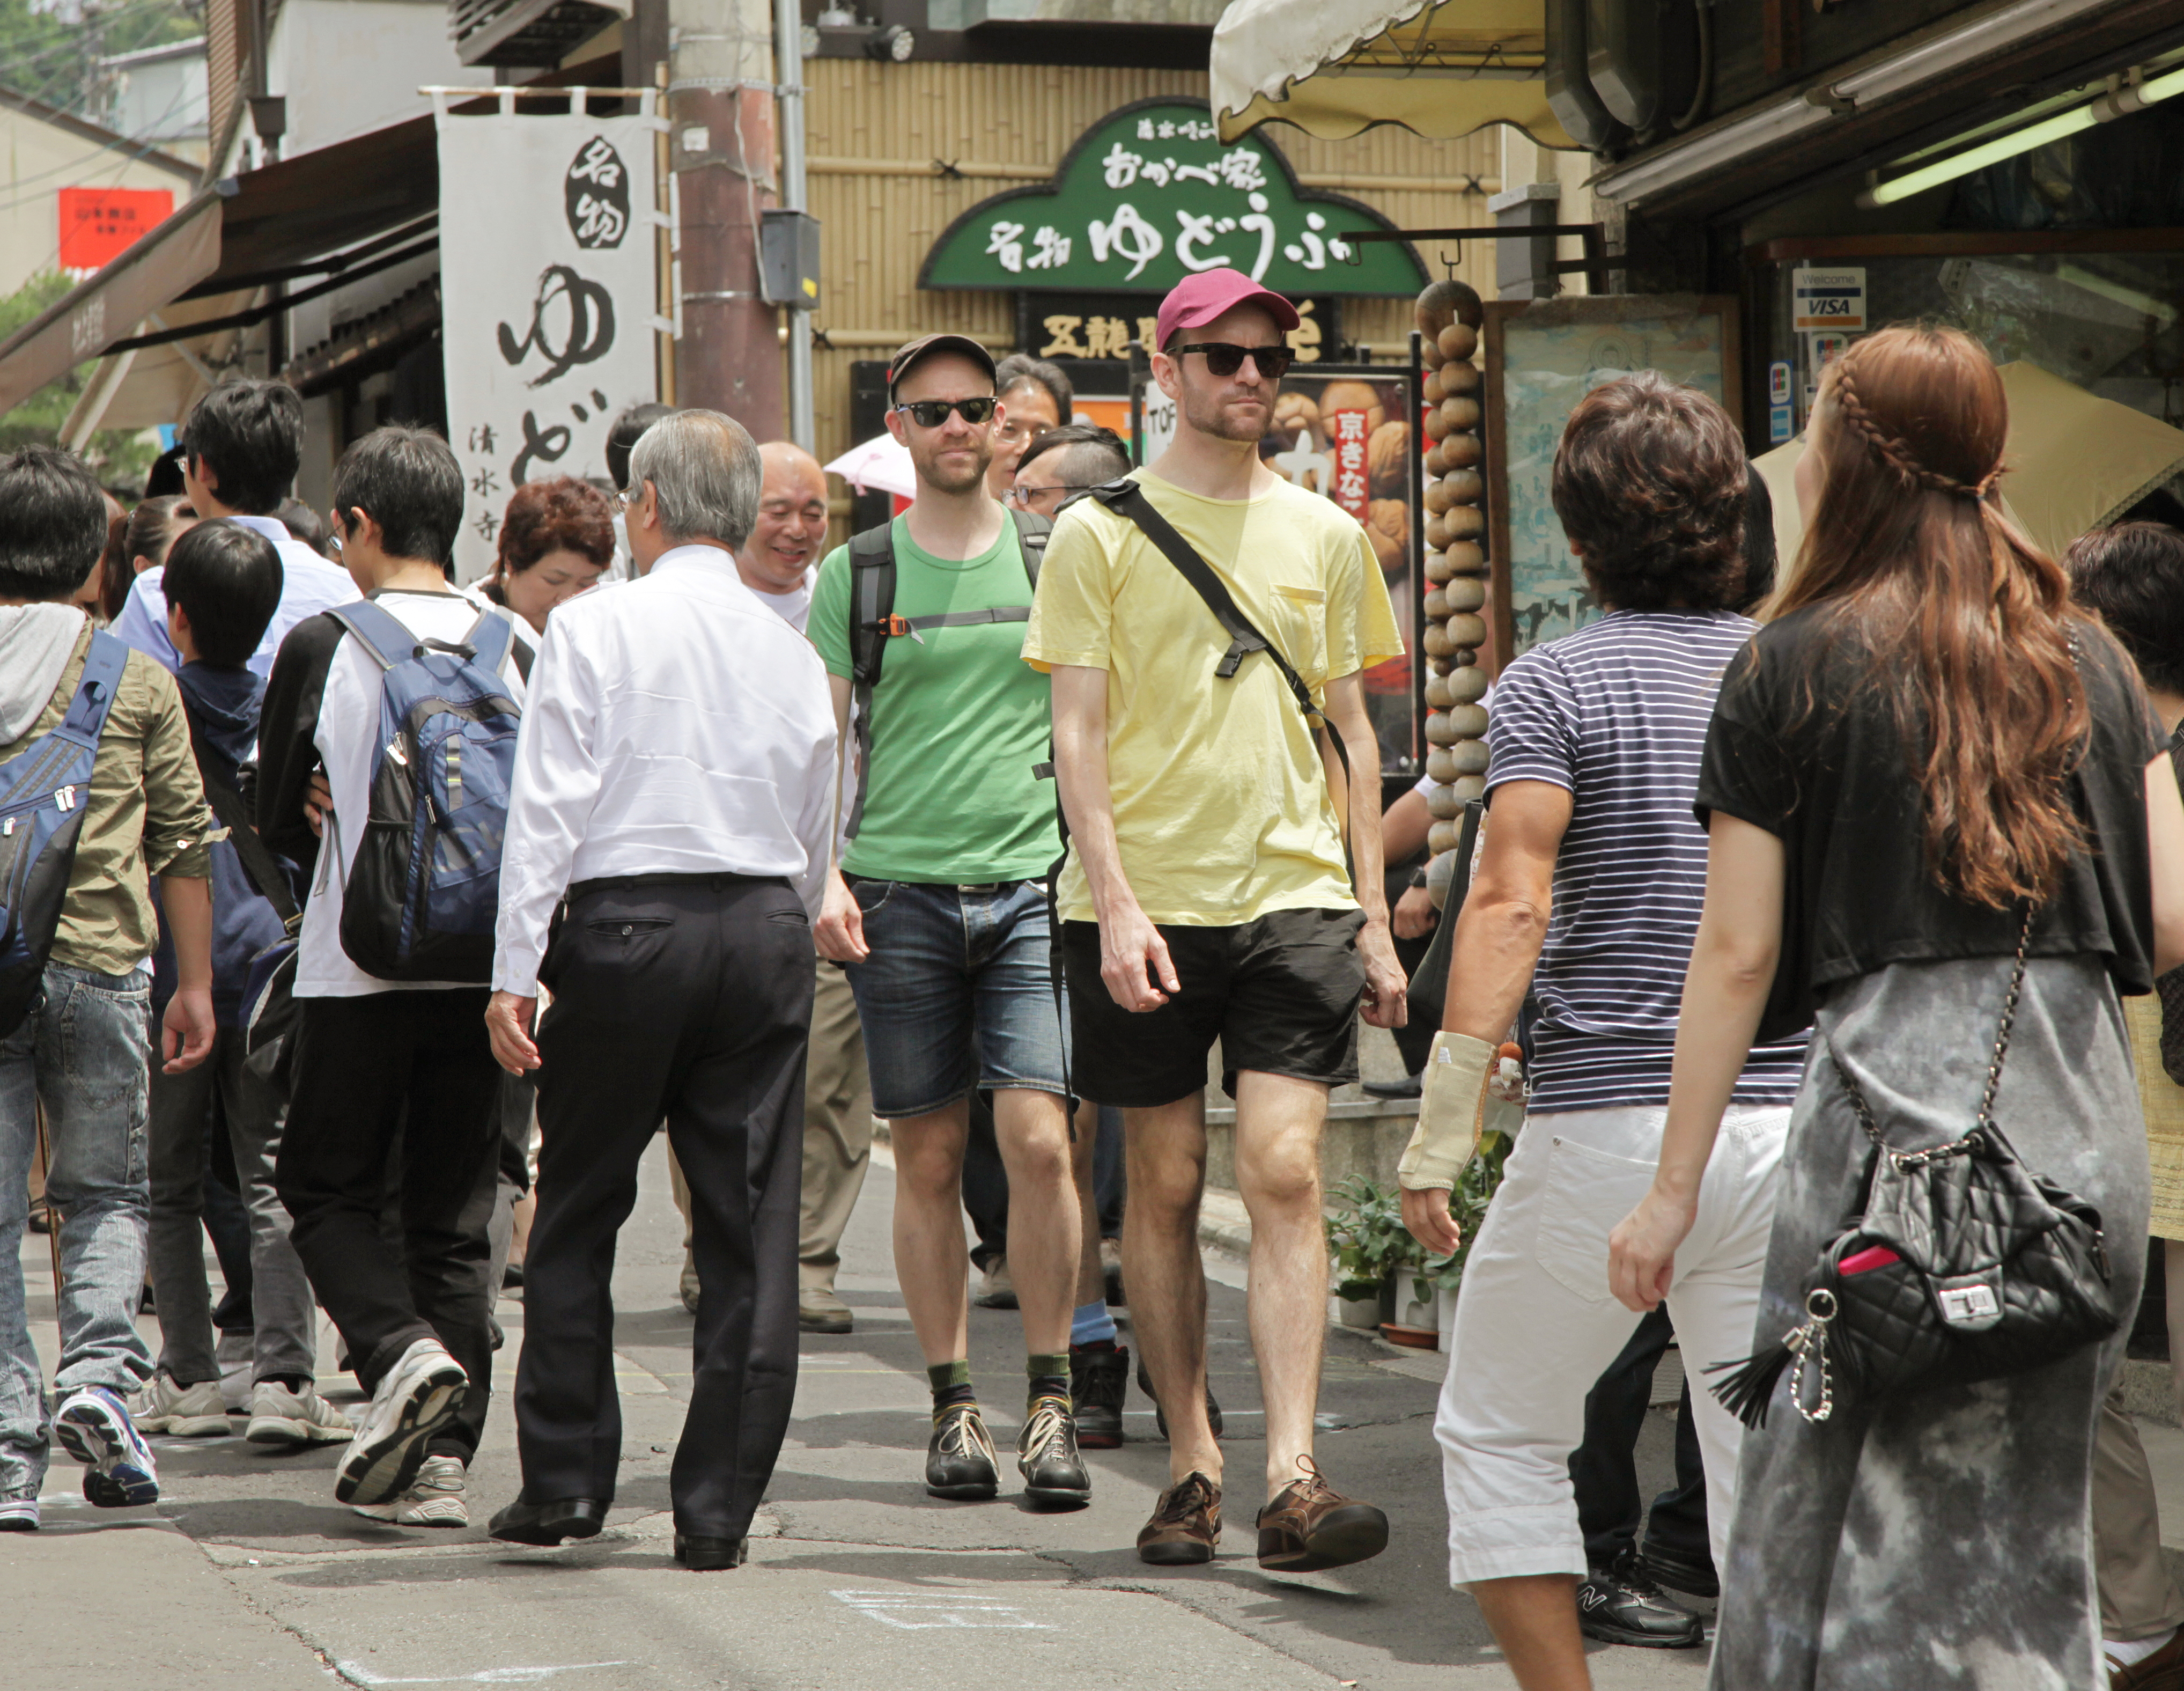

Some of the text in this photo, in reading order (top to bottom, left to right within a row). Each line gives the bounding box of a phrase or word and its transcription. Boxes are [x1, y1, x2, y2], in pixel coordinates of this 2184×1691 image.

[571, 139, 624, 248] 名物
[1102, 142, 1267, 192] おかべ家
[985, 193, 1352, 282] 名物 ゆどうふ
[1802, 274, 1856, 285] Welcome
[1808, 299, 1850, 315] VISA
[469, 422, 500, 542] 清水寺
